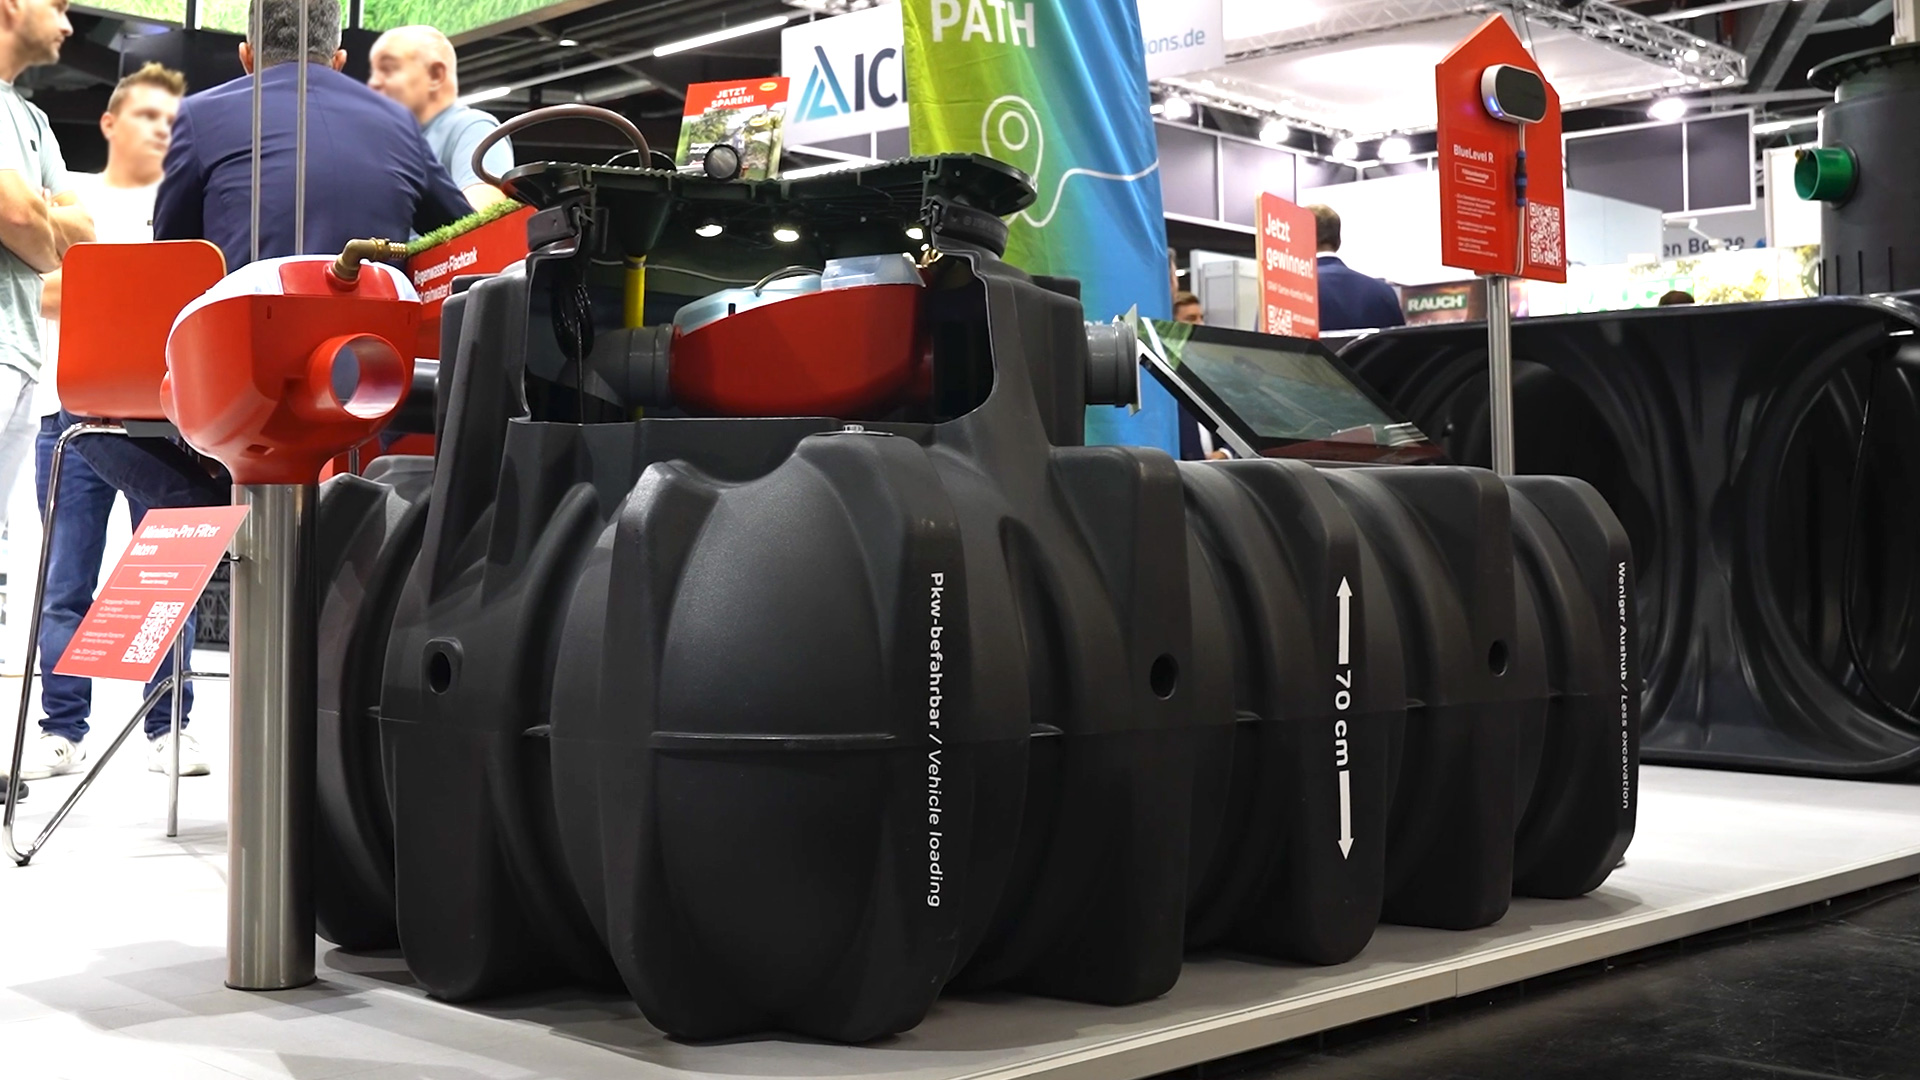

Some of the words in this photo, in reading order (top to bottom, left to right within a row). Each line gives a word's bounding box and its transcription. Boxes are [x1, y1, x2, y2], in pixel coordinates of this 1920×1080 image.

[932, 0, 1035, 47] PATH
[711, 95, 754, 109] SPAREN!
[716, 87, 747, 99] JETZT
[1453, 144, 1488, 162] BlueLevel
[1488, 152, 1494, 164] R
[1265, 213, 1291, 243] Jetzt
[1266, 247, 1314, 279] gewinnen!
[1408, 295, 1465, 311] RAUCH
[140, 524, 194, 539] Minimax-Pro
[193, 522, 220, 538] Filter
[130, 542, 158, 556] Intern
[1617, 562, 1627, 623] Weniger
[929, 572, 944, 730] Pkw-befahrbar
[1619, 625, 1628, 680] Aushub
[1335, 669, 1351, 710] 70
[1620, 694, 1629, 727] Less
[928, 734, 943, 744] /
[1335, 720, 1349, 767] cm
[1621, 730, 1630, 809] excavation
[928, 750, 942, 825] Vehicle
[927, 831, 943, 908] loading
